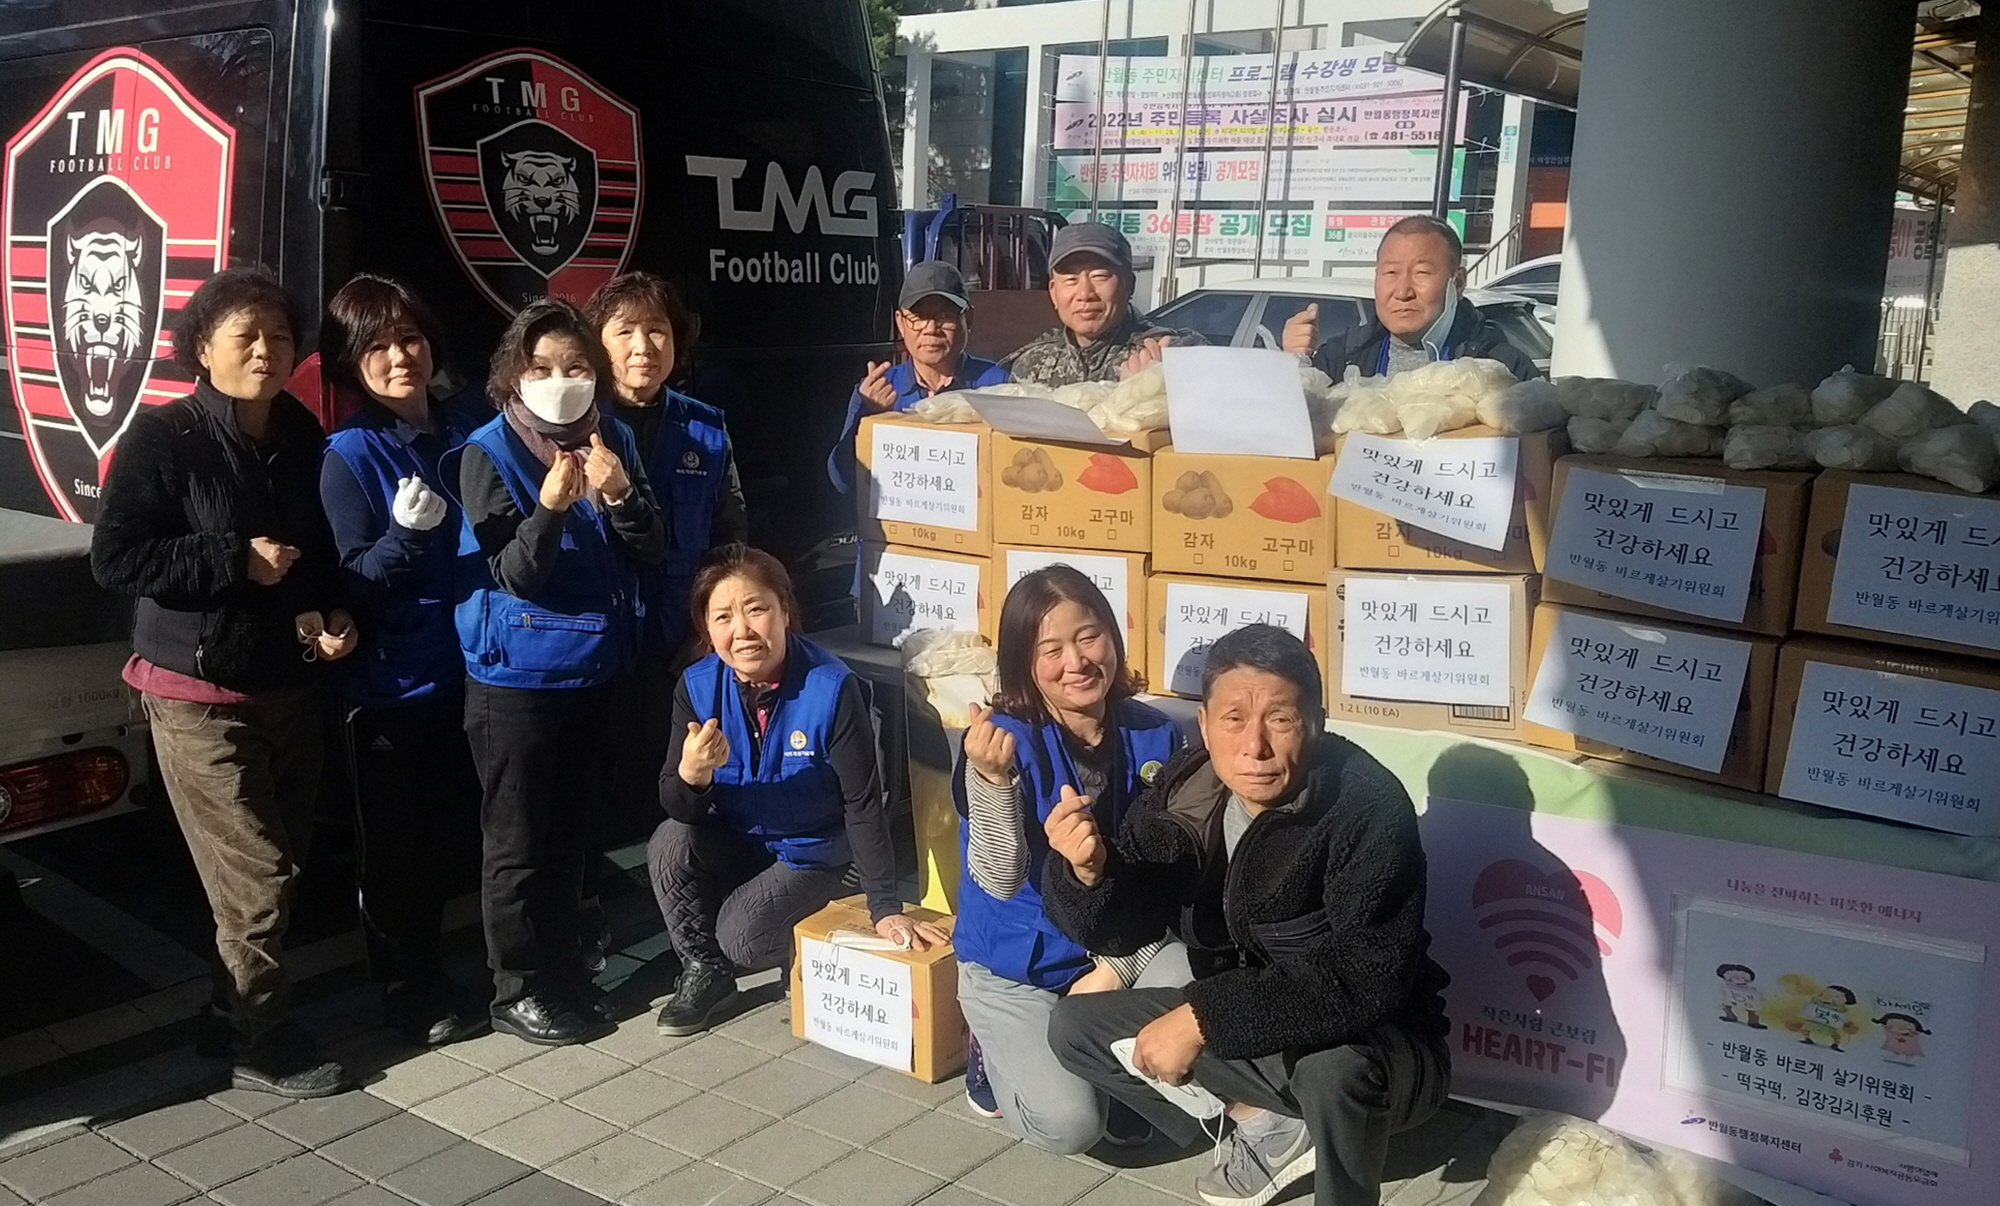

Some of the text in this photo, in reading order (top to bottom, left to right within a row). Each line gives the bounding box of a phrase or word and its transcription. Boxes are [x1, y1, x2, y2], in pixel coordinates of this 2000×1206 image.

[1301, 58, 1357, 80] 수강생
[485, 76, 580, 112] TMG
[473, 103, 595, 123] FOOTBALL CLUB
[1229, 107, 1309, 125] 사실조사
[1317, 106, 1357, 124] 실시
[67, 107, 160, 156] TMG
[50, 155, 172, 173] FOOTBALL CLUB
[1111, 161, 1158, 182] 주민자치회
[1216, 159, 1259, 182] 공개모집
[685, 155, 878, 237] TMG
[1146, 212, 1215, 235] 36통장
[1219, 213, 1260, 238] 공개
[1268, 213, 1312, 238] 모집
[709, 249, 880, 286] Football Club
[883, 442, 966, 466] 맛있게 드시고
[1362, 447, 1498, 480] 맛있게 드시고
[892, 470, 956, 492] 건강하세요
[1372, 470, 1476, 510] 건강하세요
[906, 497, 965, 515] 바르게살기위원회
[1021, 504, 1135, 527] 감자 고구마
[1391, 496, 1487, 533] 바르게살기위원회
[1583, 491, 1740, 532] 맛있게 드시고
[912, 526, 937, 542] 10kg
[1056, 525, 1086, 540] 10kg
[1868, 511, 1948, 546] 맛있게
[1183, 531, 1315, 557] 감자 고구마
[1592, 526, 1714, 567] 건강하세요
[1224, 554, 1258, 571] 10kg
[1569, 552, 1609, 574] 반월동
[1615, 565, 1727, 598] 바르게살기위원회
[884, 570, 967, 596] 맛있게 드시고
[892, 598, 957, 621] 건강하세요
[1361, 600, 1492, 626] 맛있게 드시고
[1855, 590, 1900, 611] 반월동
[1180, 604, 1290, 630] 맛있게 드시고
[1374, 634, 1476, 660] 건강하세요
[1569, 635, 1723, 683] 맛있게 드시고
[1177, 663, 1201, 678] 반월동
[1359, 665, 1491, 687] 반월동 바르게살기위원회
[1575, 672, 1695, 716] 건강하세요
[1339, 702, 1400, 719] 1.2 L (10 EA)
[1550, 696, 1590, 718] 반월동
[1596, 709, 1706, 748] 바르게살기위원회
[1822, 689, 1998, 739] 맛있게 드시고
[1832, 732, 1967, 776] 건강하세요
[1807, 766, 1981, 814] 반월동 바르게살기위원회
[1524, 883, 1566, 901] ANSAN
[811, 958, 900, 997] 맛있게 드시고
[821, 991, 889, 1026] 건강하세요
[1481, 1004, 1545, 1033] 작은사랑
[1462, 1022, 1617, 1089] HEART-FI
[1721, 1039, 1769, 1068] 반월동
[1775, 1052, 1824, 1082] 바르게
[1832, 1067, 1915, 1104] 살기위원회
[1736, 1071, 1787, 1102] 떡국떡,
[1795, 1086, 1893, 1129] 김장김치후원
[1707, 1118, 1802, 1154] 반월동행정복지센터
